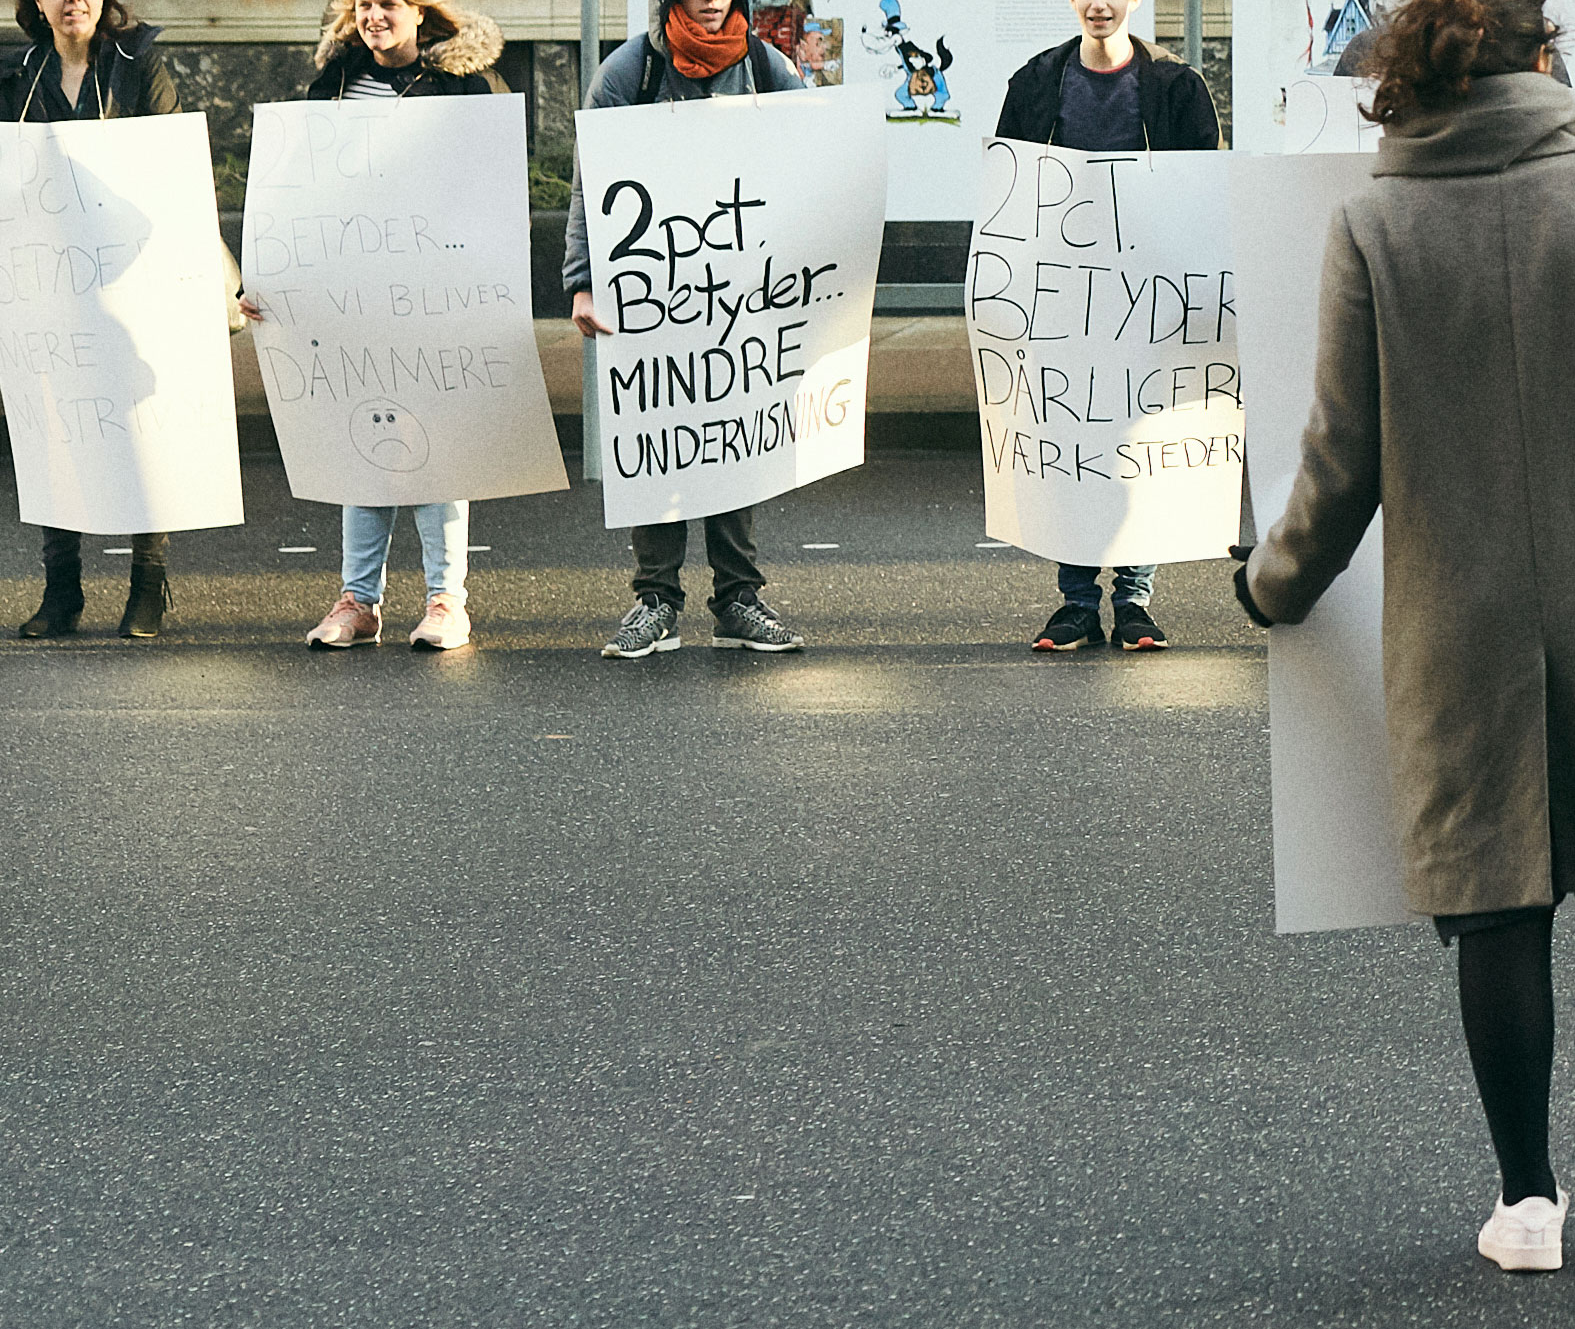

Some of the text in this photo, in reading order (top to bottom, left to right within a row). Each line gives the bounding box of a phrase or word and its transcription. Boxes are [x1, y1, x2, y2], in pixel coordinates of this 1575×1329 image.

[254, 283, 515, 328] AT VI BLIVER
[608, 255, 844, 347] Betyder...
[609, 320, 809, 416] MINDRE
[613, 378, 852, 479] UNDERVISNING
[986, 418, 1243, 483] VÆRKSTEDER
